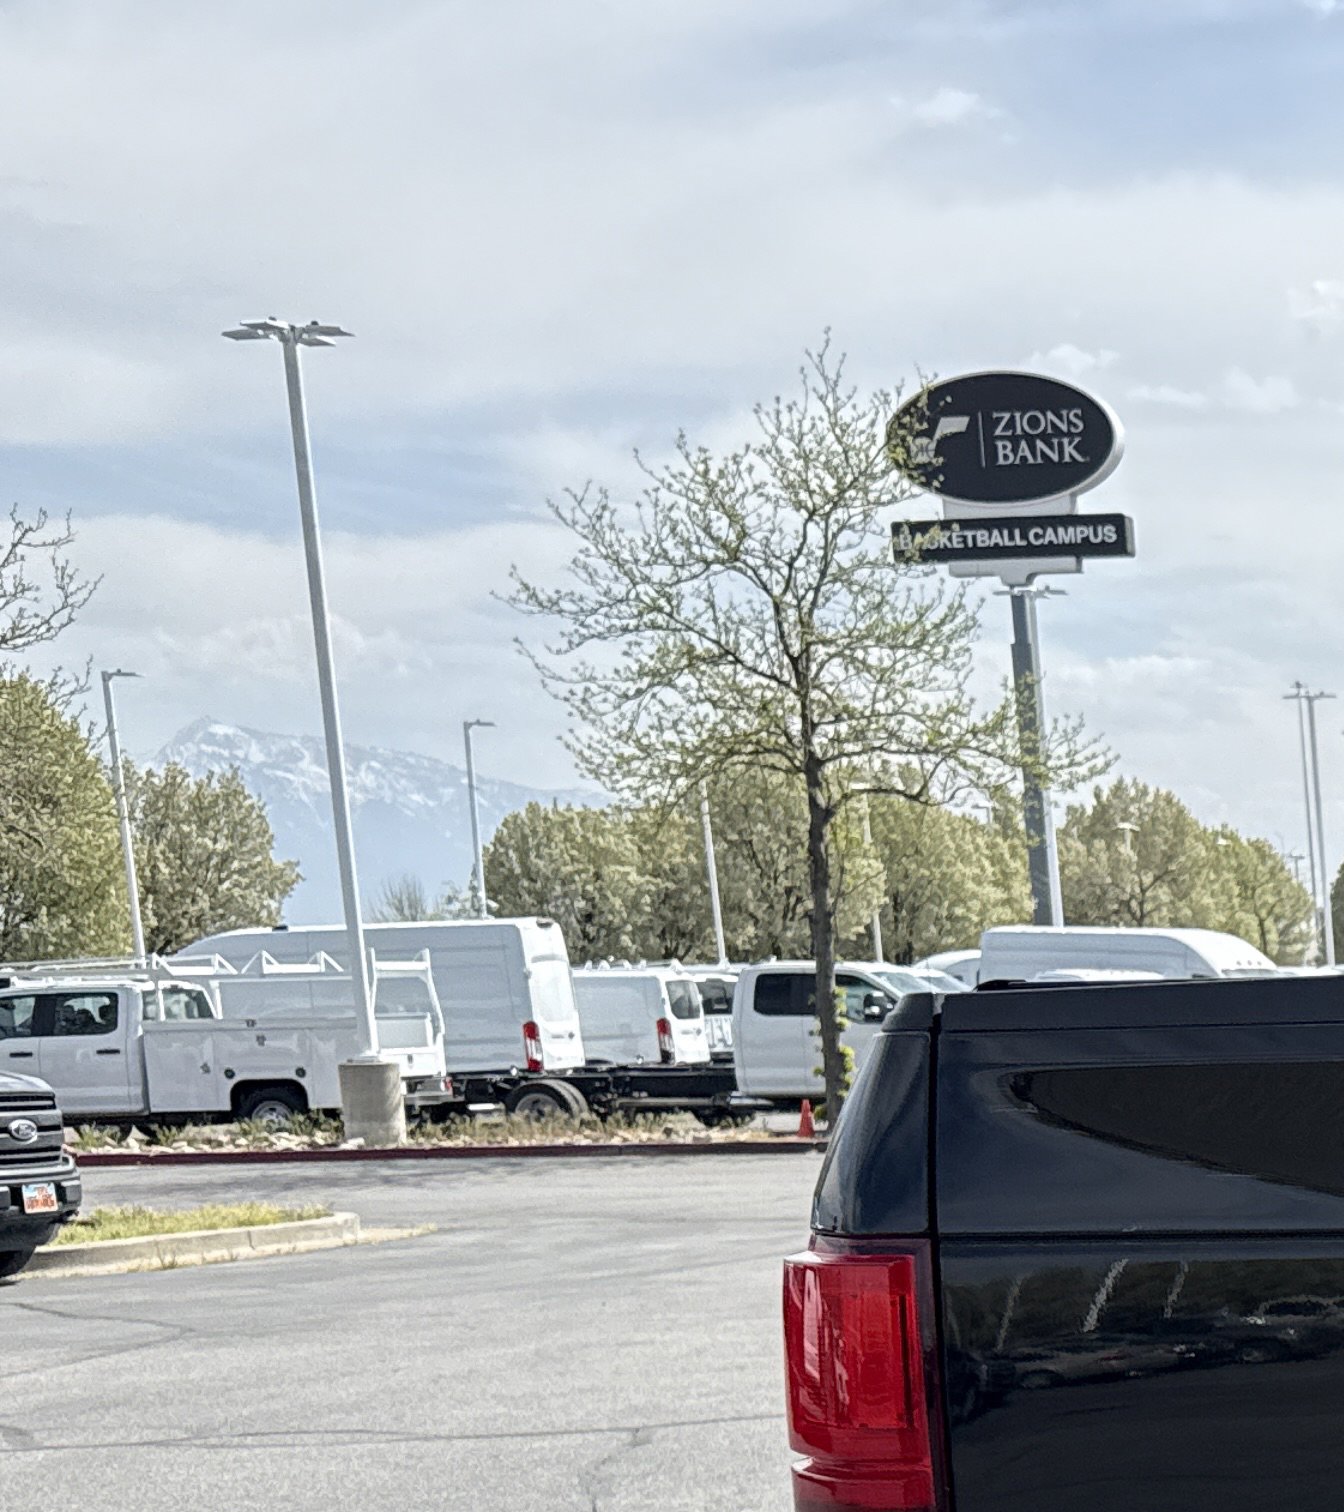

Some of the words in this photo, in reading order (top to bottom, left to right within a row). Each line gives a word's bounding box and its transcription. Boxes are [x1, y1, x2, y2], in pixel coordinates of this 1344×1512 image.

[991, 408, 1085, 437] ZIONS
[995, 436, 1086, 467] BANK
[1028, 524, 1118, 546] CAMPUS
